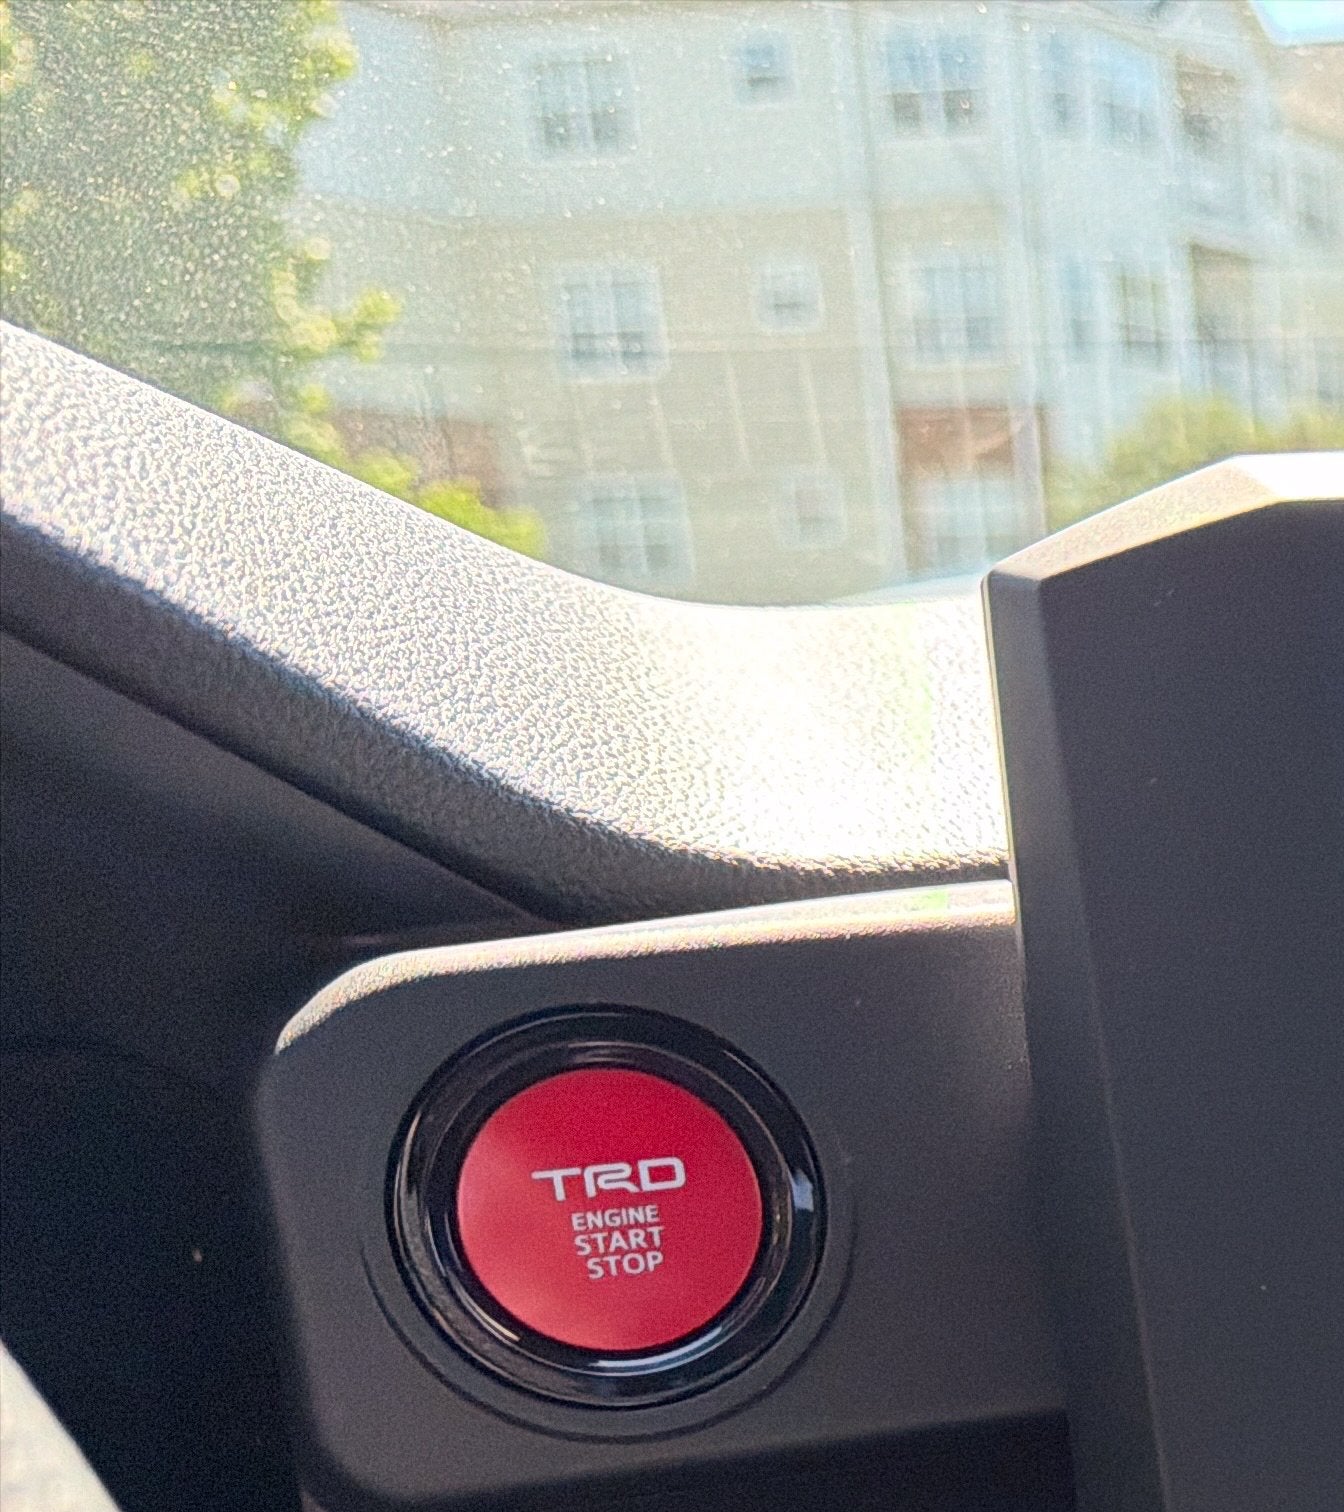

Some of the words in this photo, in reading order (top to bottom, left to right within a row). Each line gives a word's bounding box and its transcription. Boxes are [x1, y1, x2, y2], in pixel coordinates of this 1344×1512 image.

[531, 1157, 687, 1202] TRD
[571, 1205, 660, 1231] ENGINE
[573, 1226, 664, 1256] START
[586, 1251, 664, 1280] STOP
